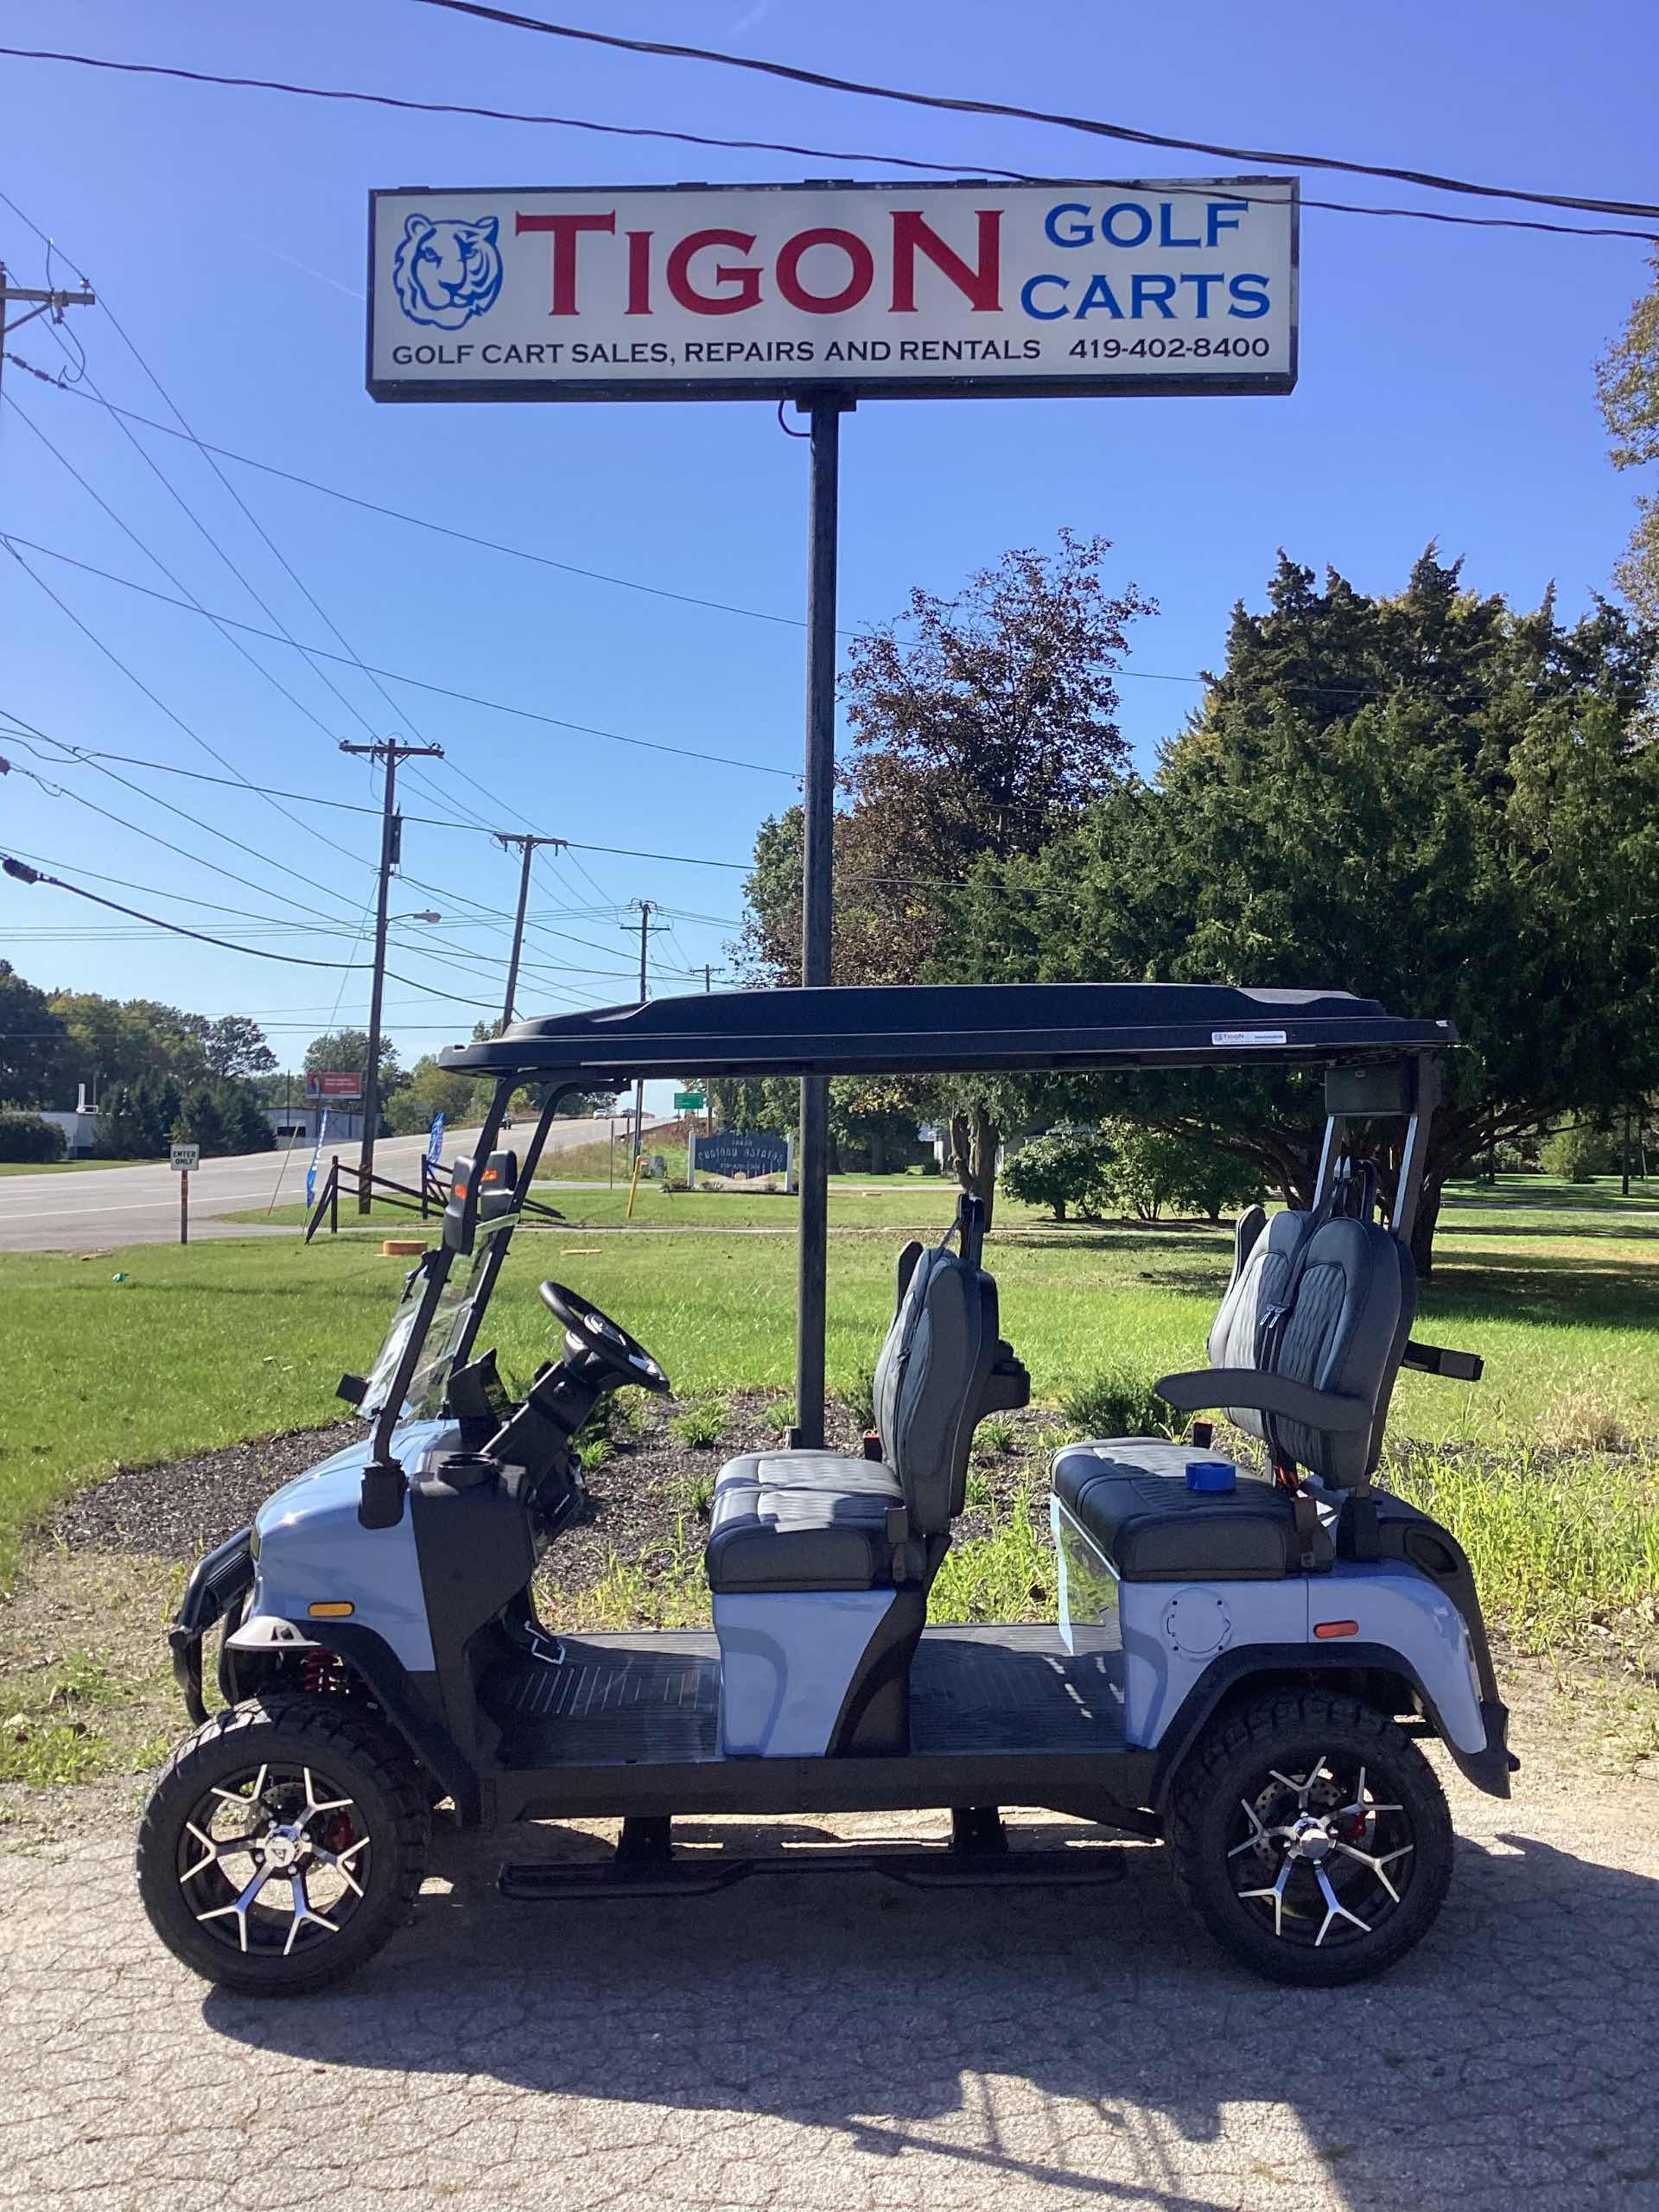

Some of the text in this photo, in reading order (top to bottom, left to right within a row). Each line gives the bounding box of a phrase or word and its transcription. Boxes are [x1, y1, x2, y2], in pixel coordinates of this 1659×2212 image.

[1043, 201, 1249, 249] GOLF
[515, 209, 1004, 316] TIGON
[1020, 271, 1271, 321] CARTS
[391, 338, 1270, 366] GOLF CART SALES, REPAIRS AND RENTALS 419-402-8400
